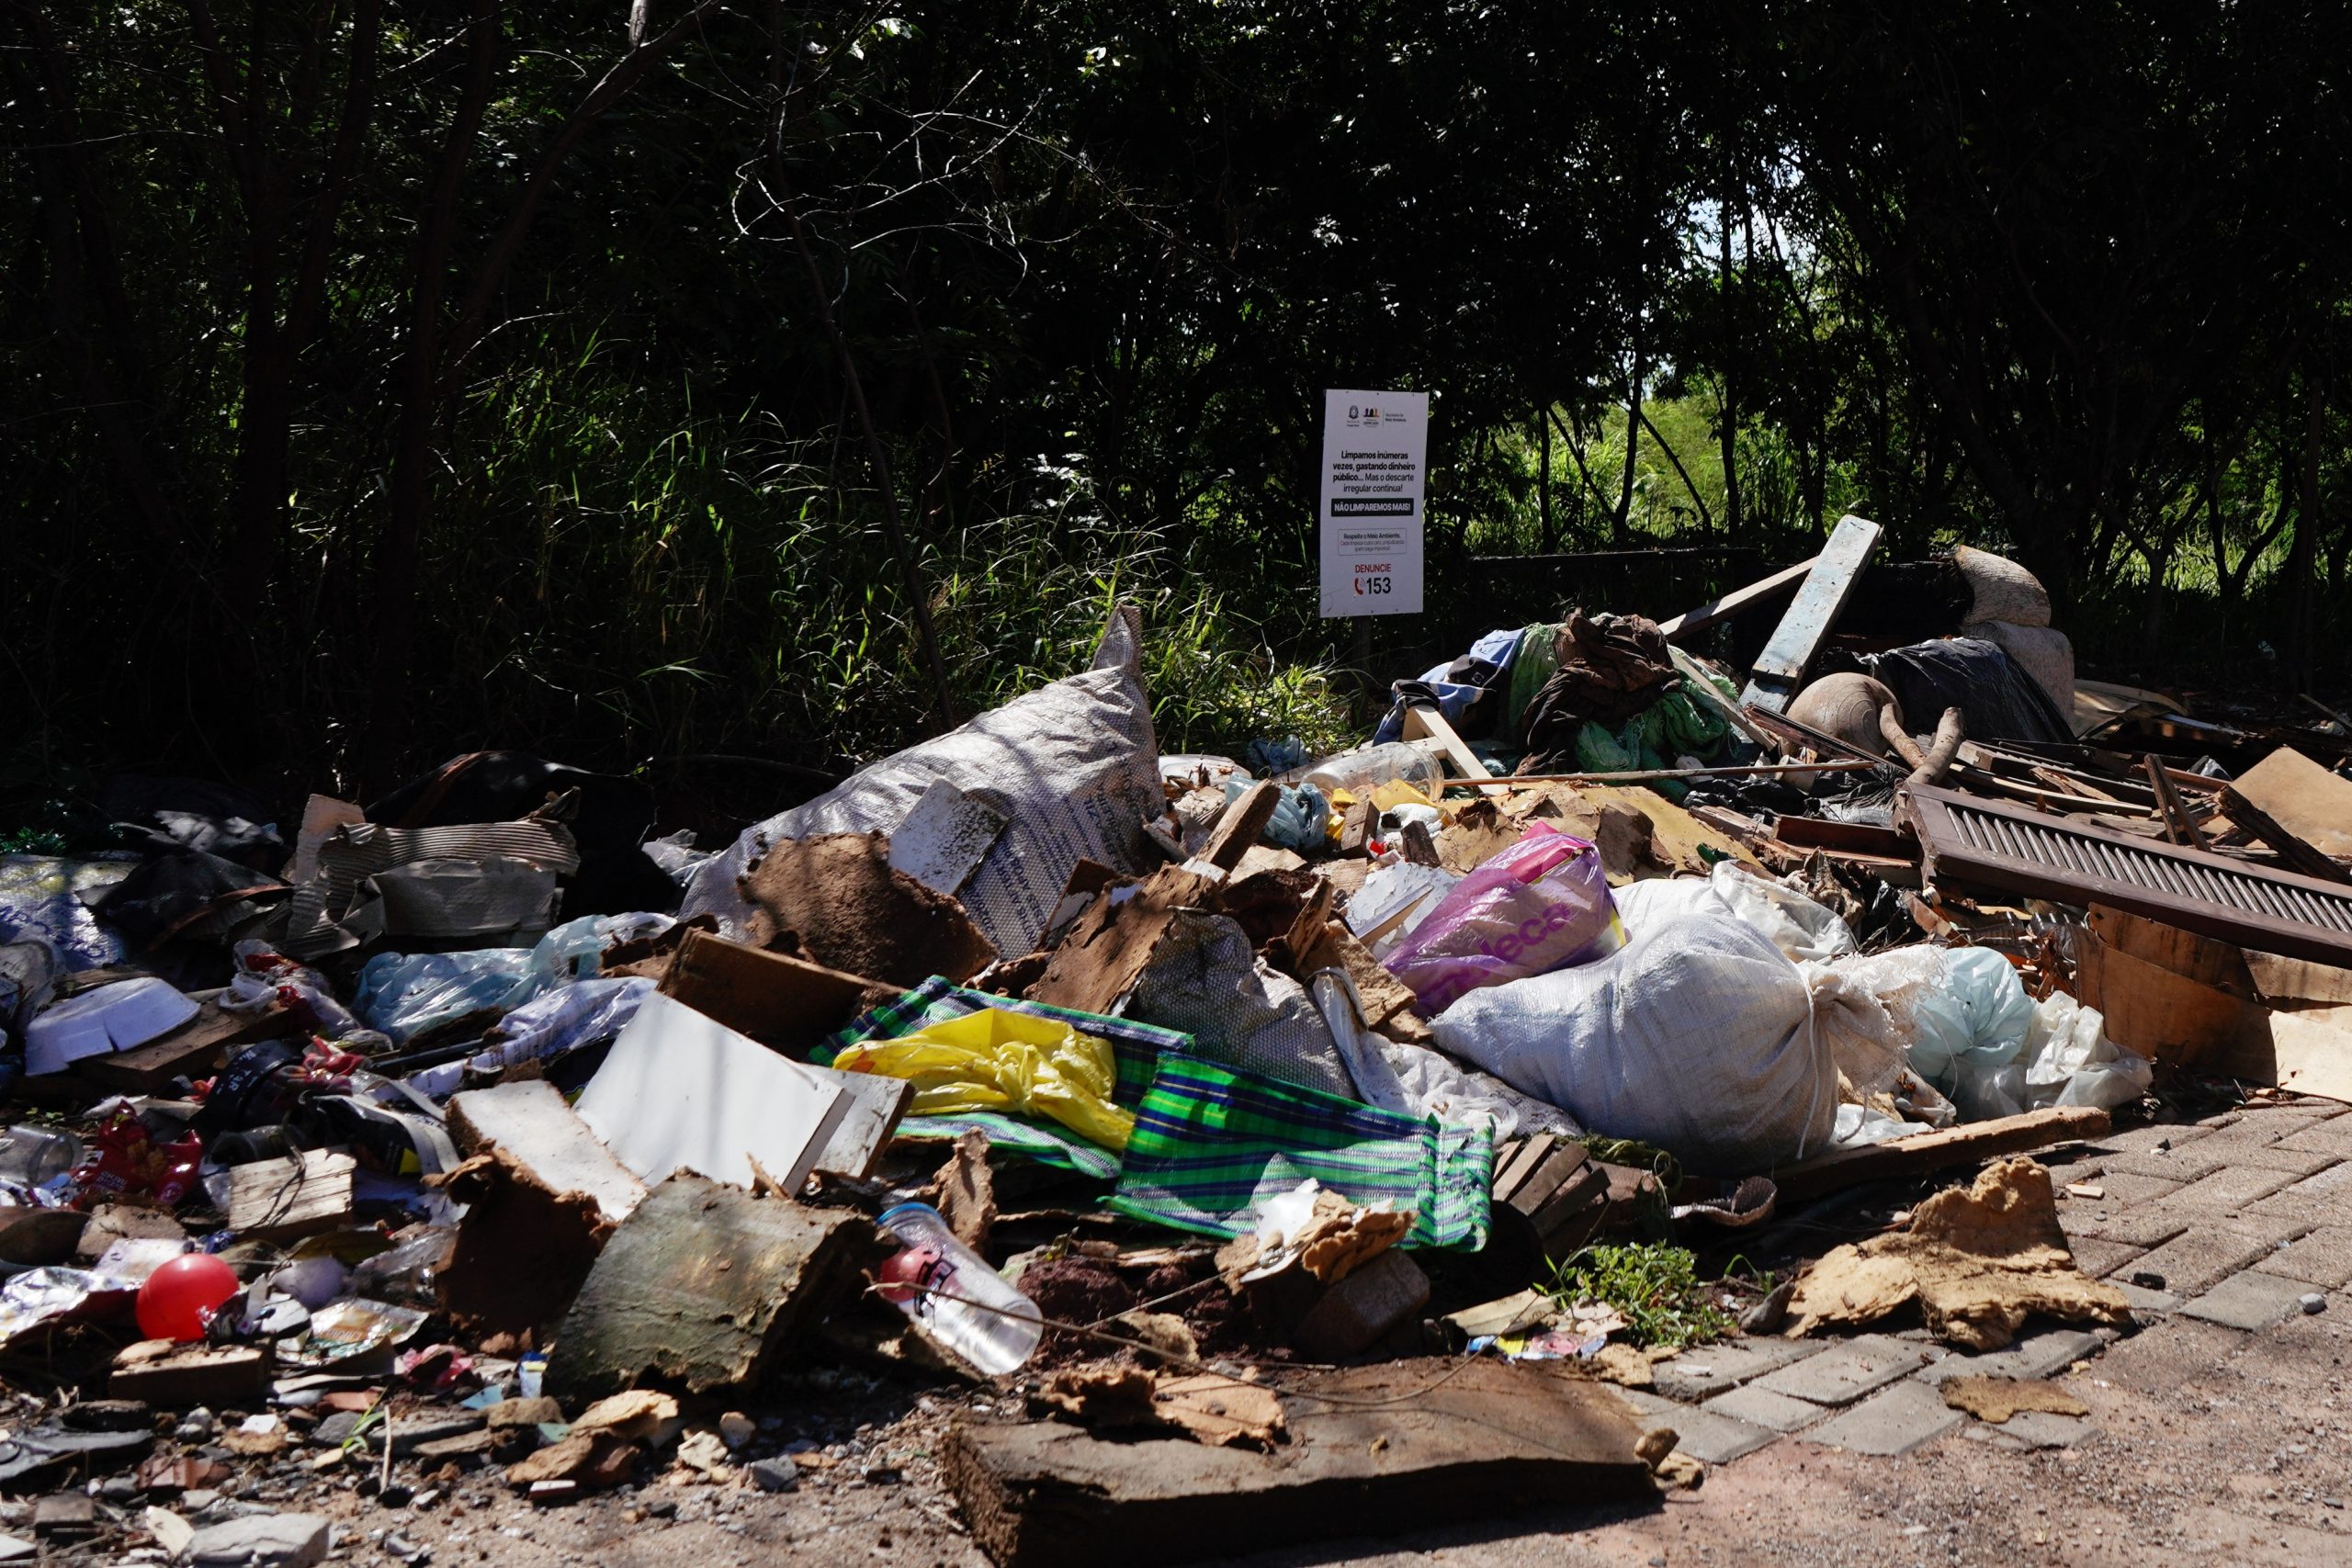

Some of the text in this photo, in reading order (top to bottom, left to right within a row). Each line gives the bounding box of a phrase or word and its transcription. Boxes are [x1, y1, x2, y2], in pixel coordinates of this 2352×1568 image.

[1341, 450, 1408, 460] Limpamos inúmeras
[1332, 462, 1416, 471] vezes, gastando dinheiro
[1365, 473, 1379, 481] Mas
[1385, 473, 1414, 481] descarte
[1343, 484, 1403, 494] irregular continua!
[1334, 502, 1411, 512] NÃO LIMPAREMOS MAIS!
[1354, 563, 1392, 573] DENUNCIE
[1366, 577, 1392, 594] 153
[995, 864, 1023, 907] AFTER
